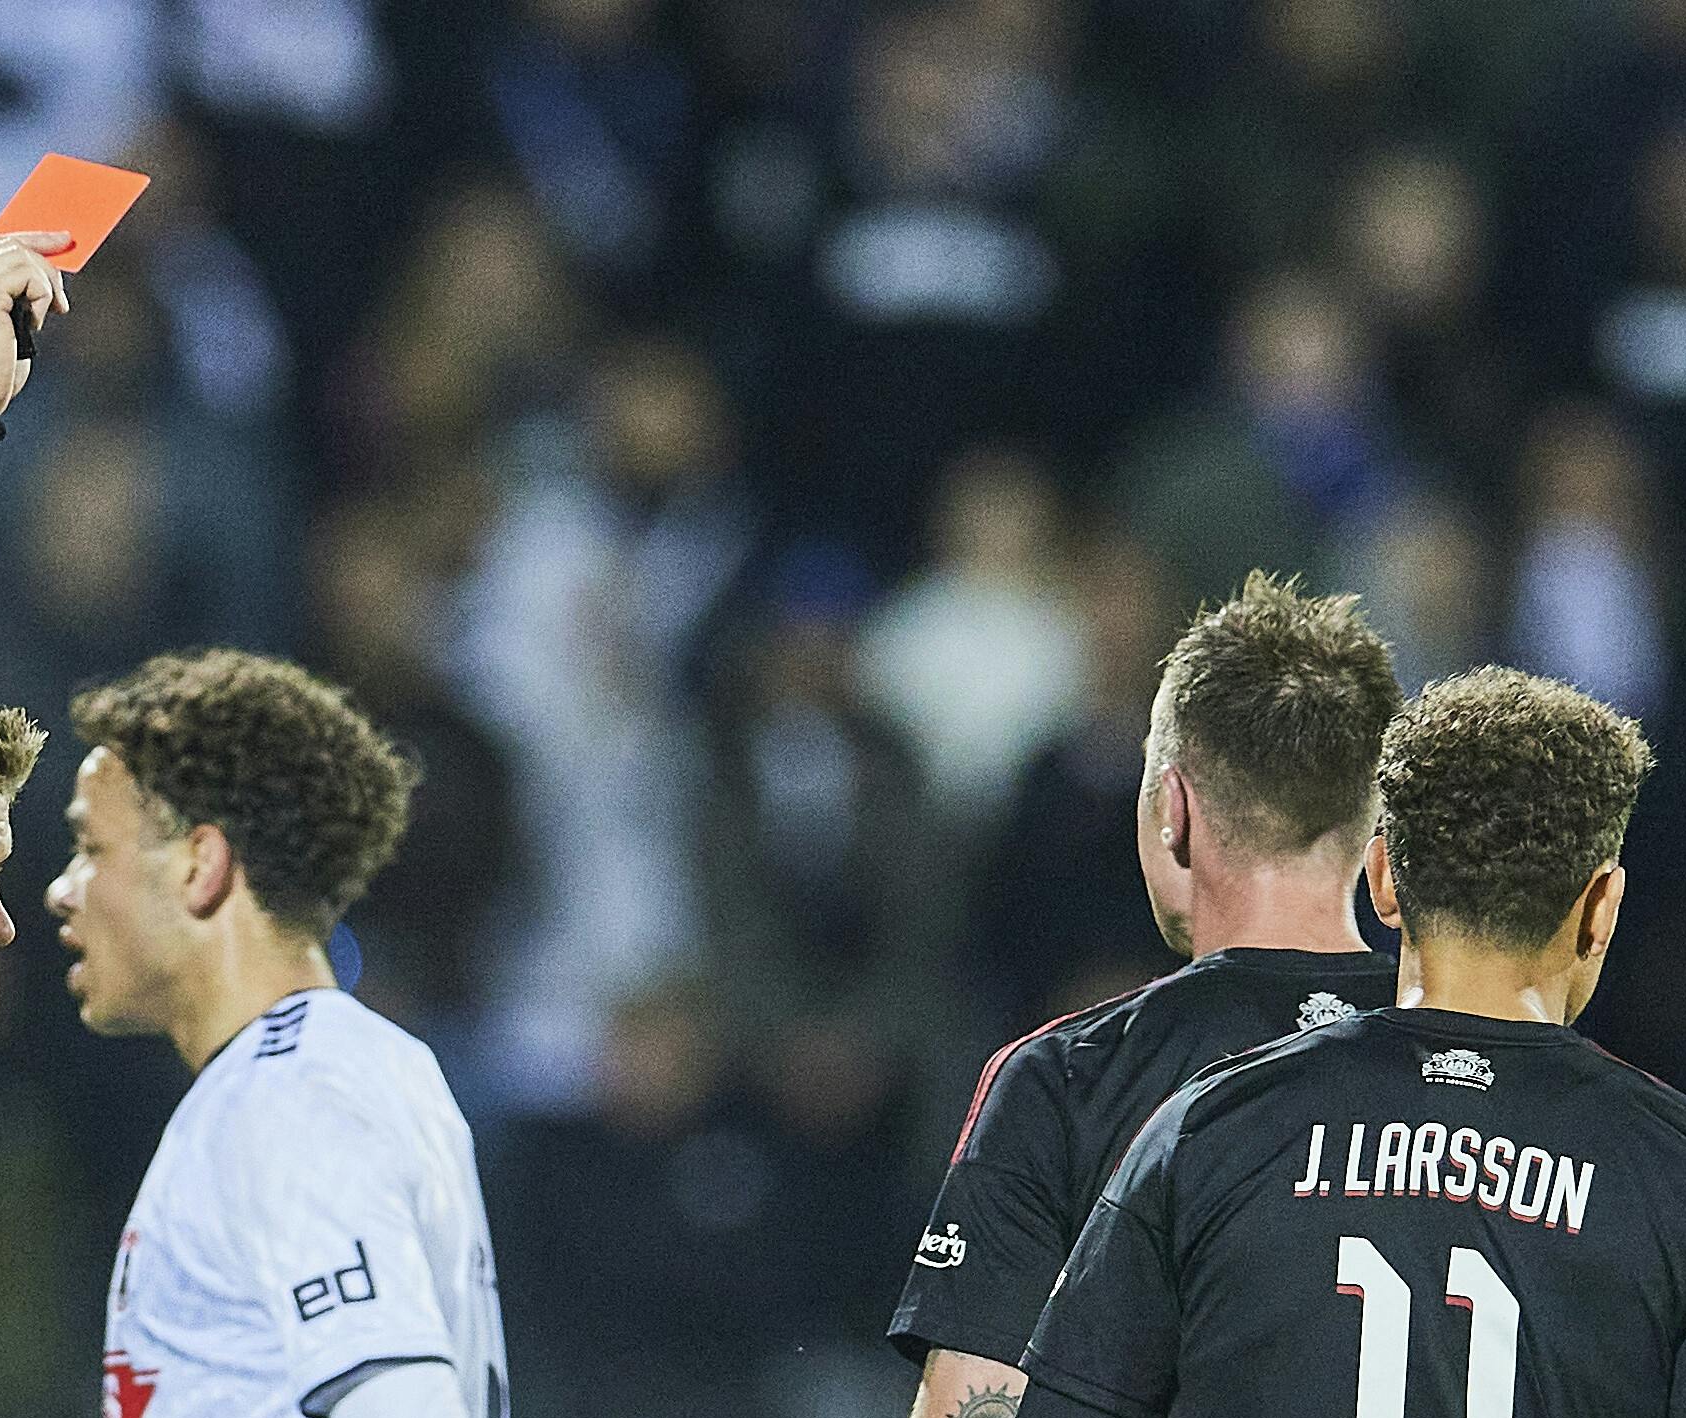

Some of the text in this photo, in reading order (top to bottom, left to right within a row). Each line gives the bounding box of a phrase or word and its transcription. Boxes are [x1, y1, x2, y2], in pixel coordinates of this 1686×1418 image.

[1294, 1121, 1596, 1235] J. LARSSON
[292, 1239, 376, 1322] ed
